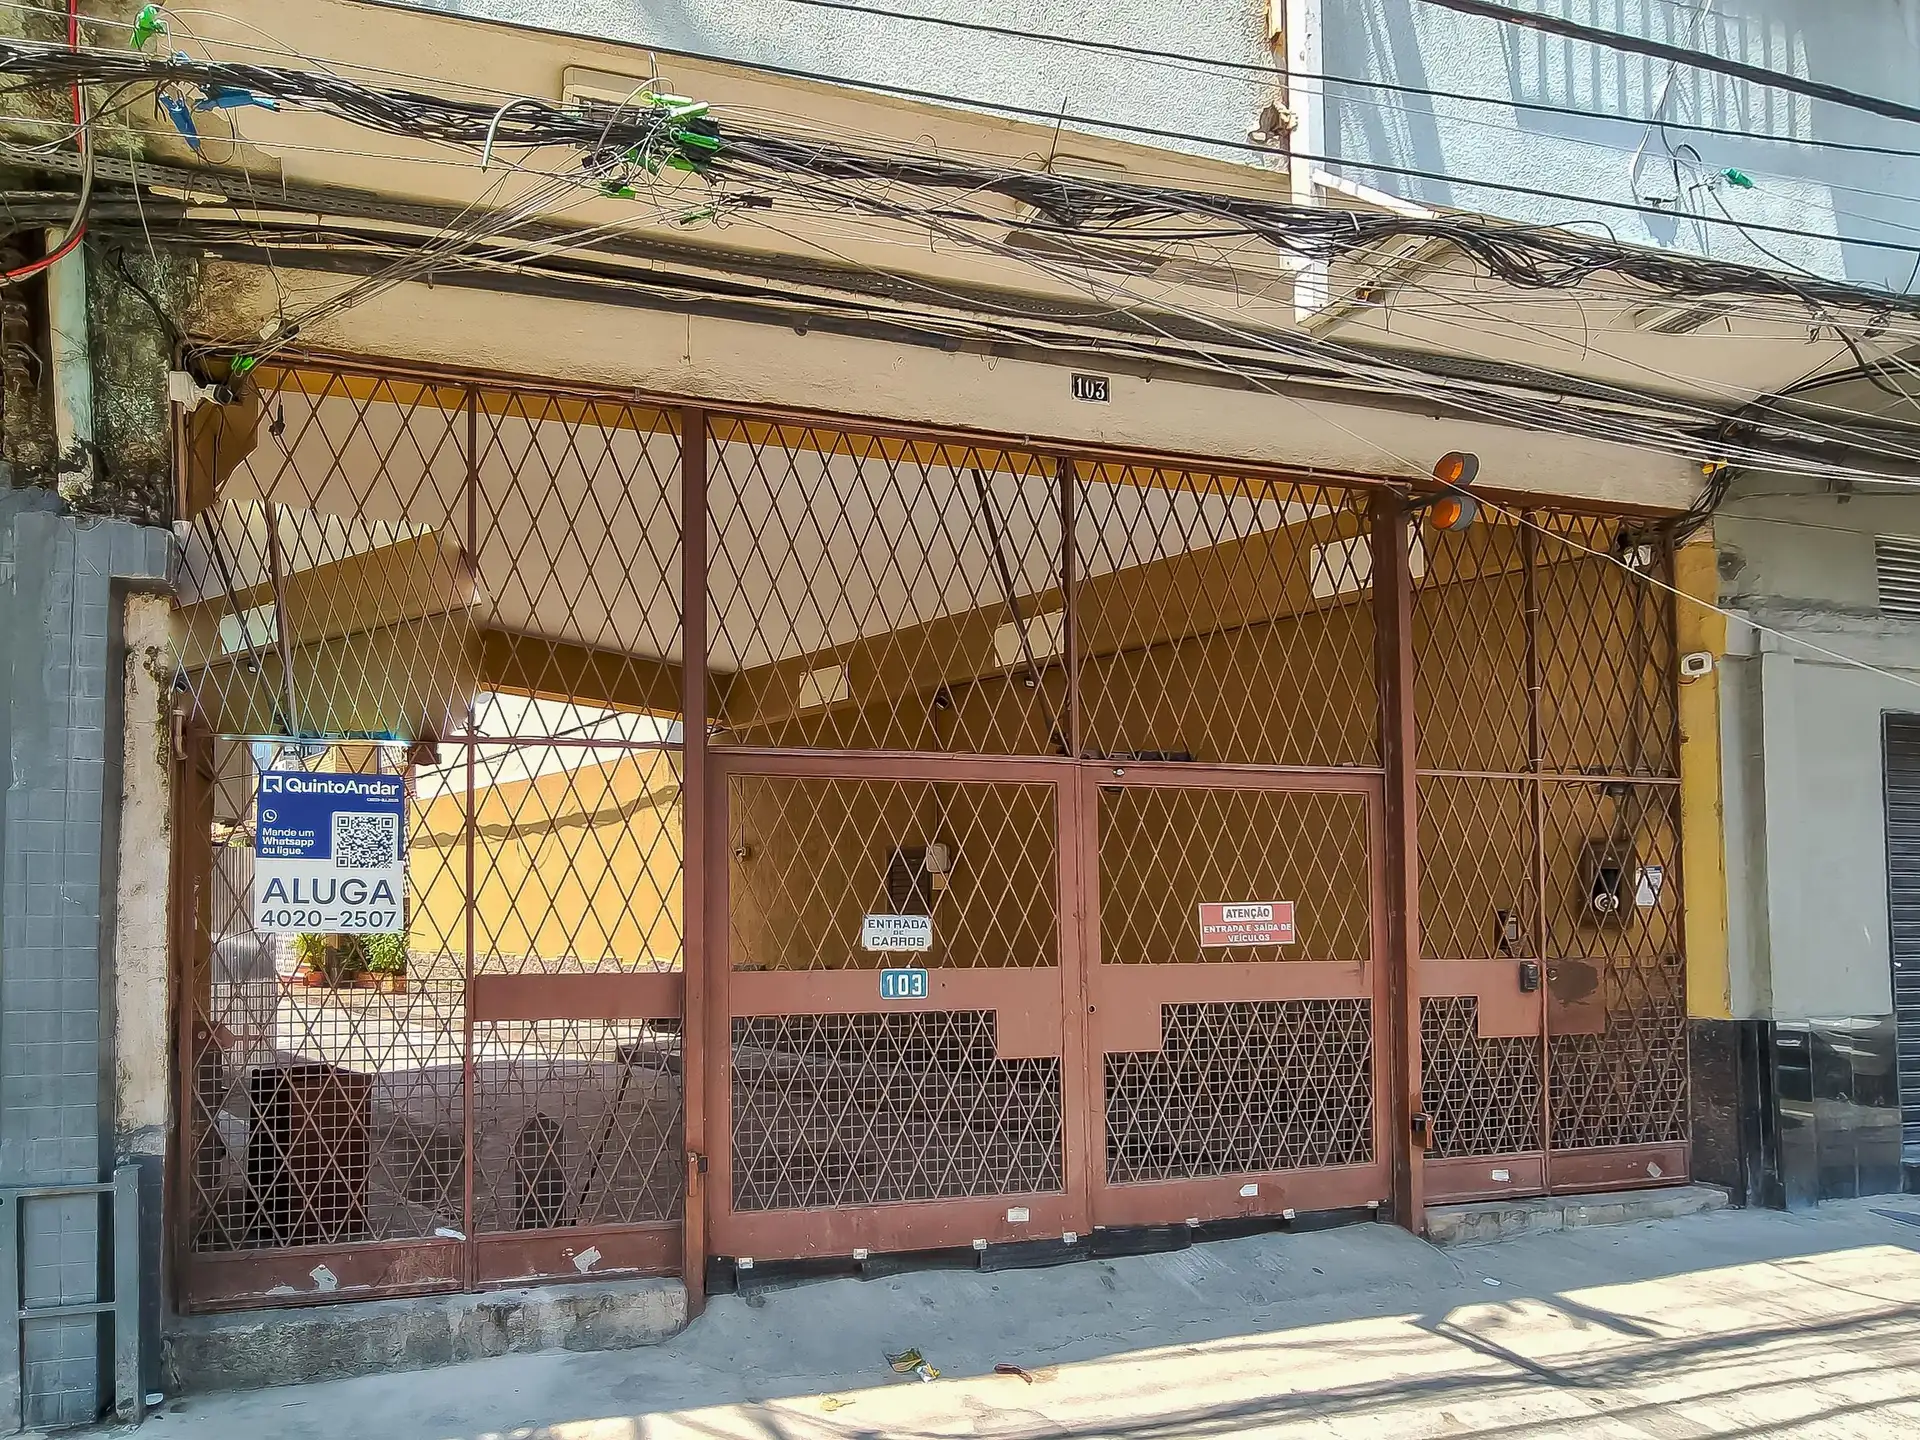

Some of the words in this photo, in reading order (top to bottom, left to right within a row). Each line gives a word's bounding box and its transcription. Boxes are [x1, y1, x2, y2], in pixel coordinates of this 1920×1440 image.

[1077, 377, 1105, 400] 103
[285, 778, 399, 795] QuintoAndar
[262, 828, 297, 837] Mande
[262, 837, 314, 847] Whatsapp
[276, 846, 304, 856] ligue.
[261, 877, 397, 905] ALUGA
[260, 910, 397, 928] 4020-2507
[1226, 907, 1270, 919] ATENÇÃO
[868, 919, 928, 929] ENTRADA
[1203, 924, 1244, 934] ENTRADA
[1246, 924, 1252, 932] E
[1254, 922, 1279, 932] SAÍDA
[1280, 923, 1292, 931] DE
[871, 936, 925, 947] CARROS
[1227, 934, 1270, 943] VEÍCULOS
[886, 974, 922, 996] 103
